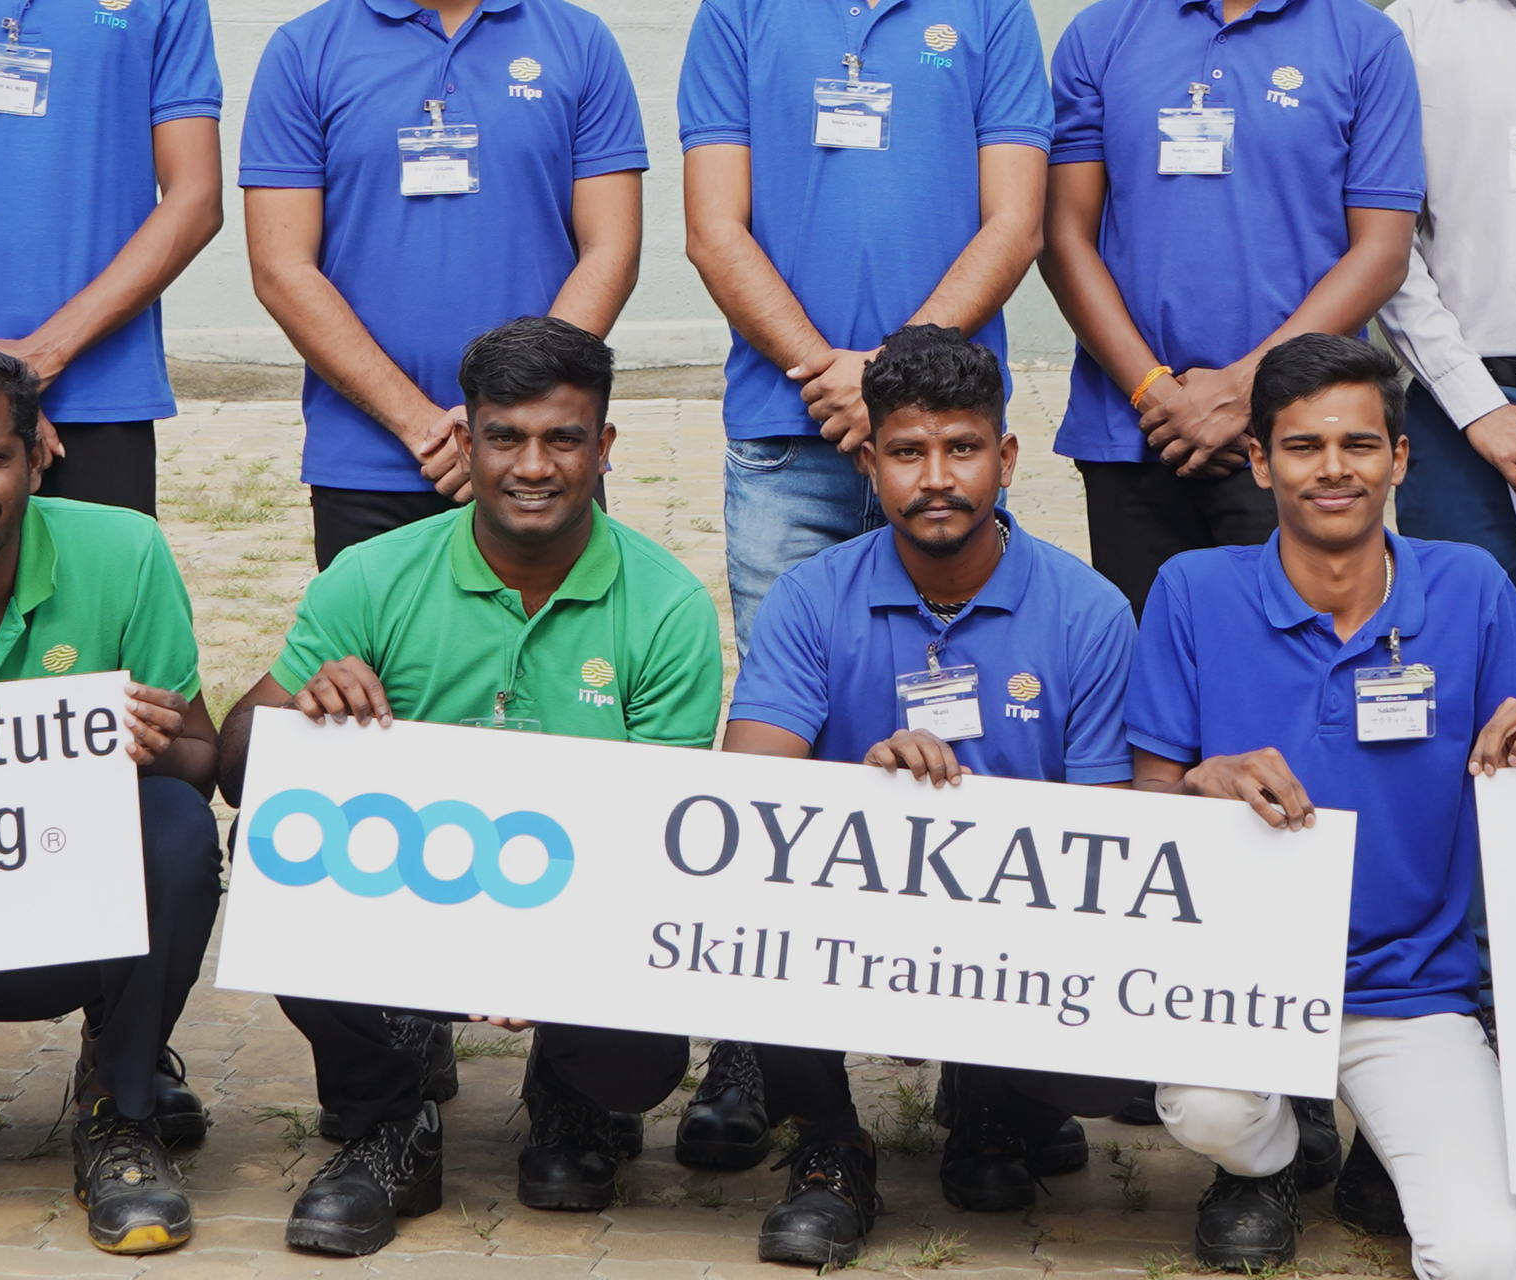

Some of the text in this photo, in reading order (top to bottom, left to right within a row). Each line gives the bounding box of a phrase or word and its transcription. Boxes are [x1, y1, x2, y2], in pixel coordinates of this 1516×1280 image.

[93, 11, 128, 29] iTips
[920, 51, 954, 69] iTips
[509, 85, 543, 101] iTips
[1266, 89, 1300, 108] iTips
[579, 688, 615, 707] iTips
[1005, 703, 1040, 722] iTips
[663, 794, 1203, 925] OYAKATA
[647, 921, 1333, 1034] Skill Training Centre
